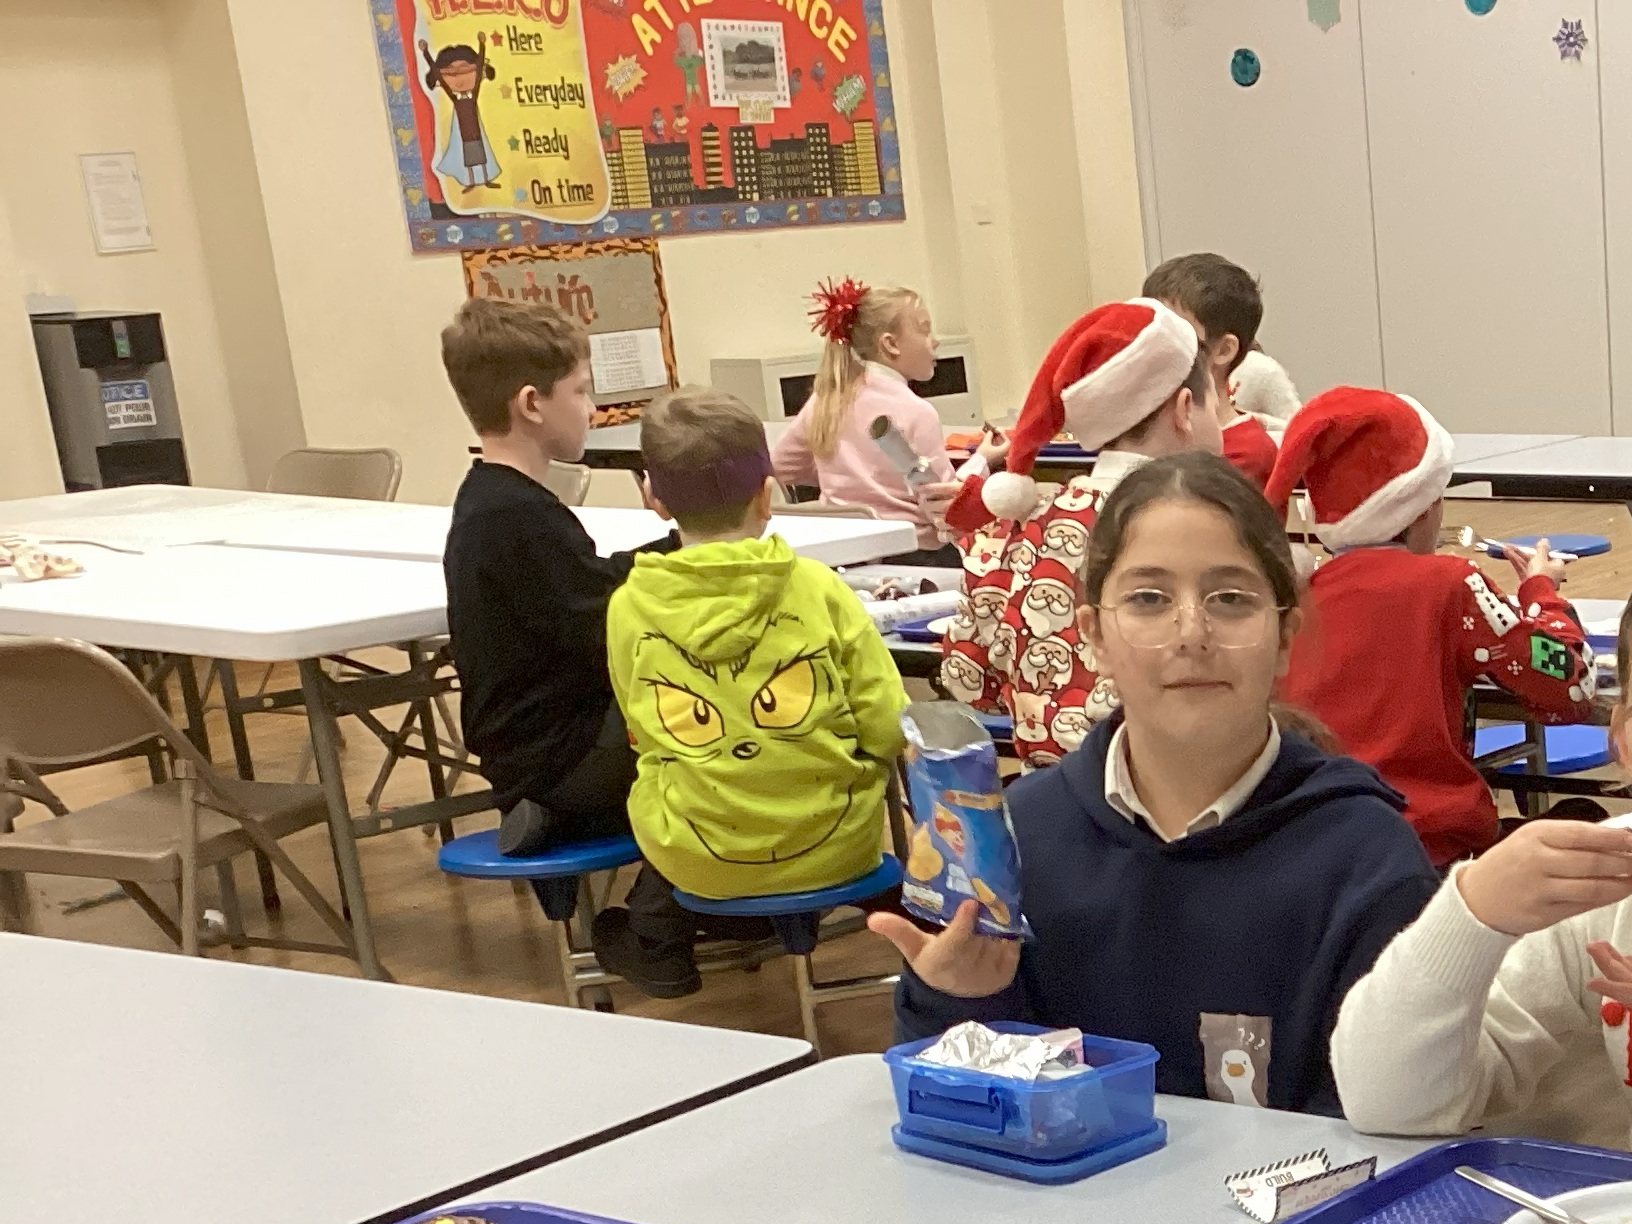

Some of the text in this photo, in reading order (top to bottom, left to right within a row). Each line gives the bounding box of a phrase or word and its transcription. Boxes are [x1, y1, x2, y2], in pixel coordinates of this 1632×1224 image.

[506, 25, 543, 52] Here
[514, 76, 585, 109] Everyday
[522, 127, 570, 160] Ready
[531, 178, 595, 205] On time
[1265, 1171, 1295, 1188] BUILD
